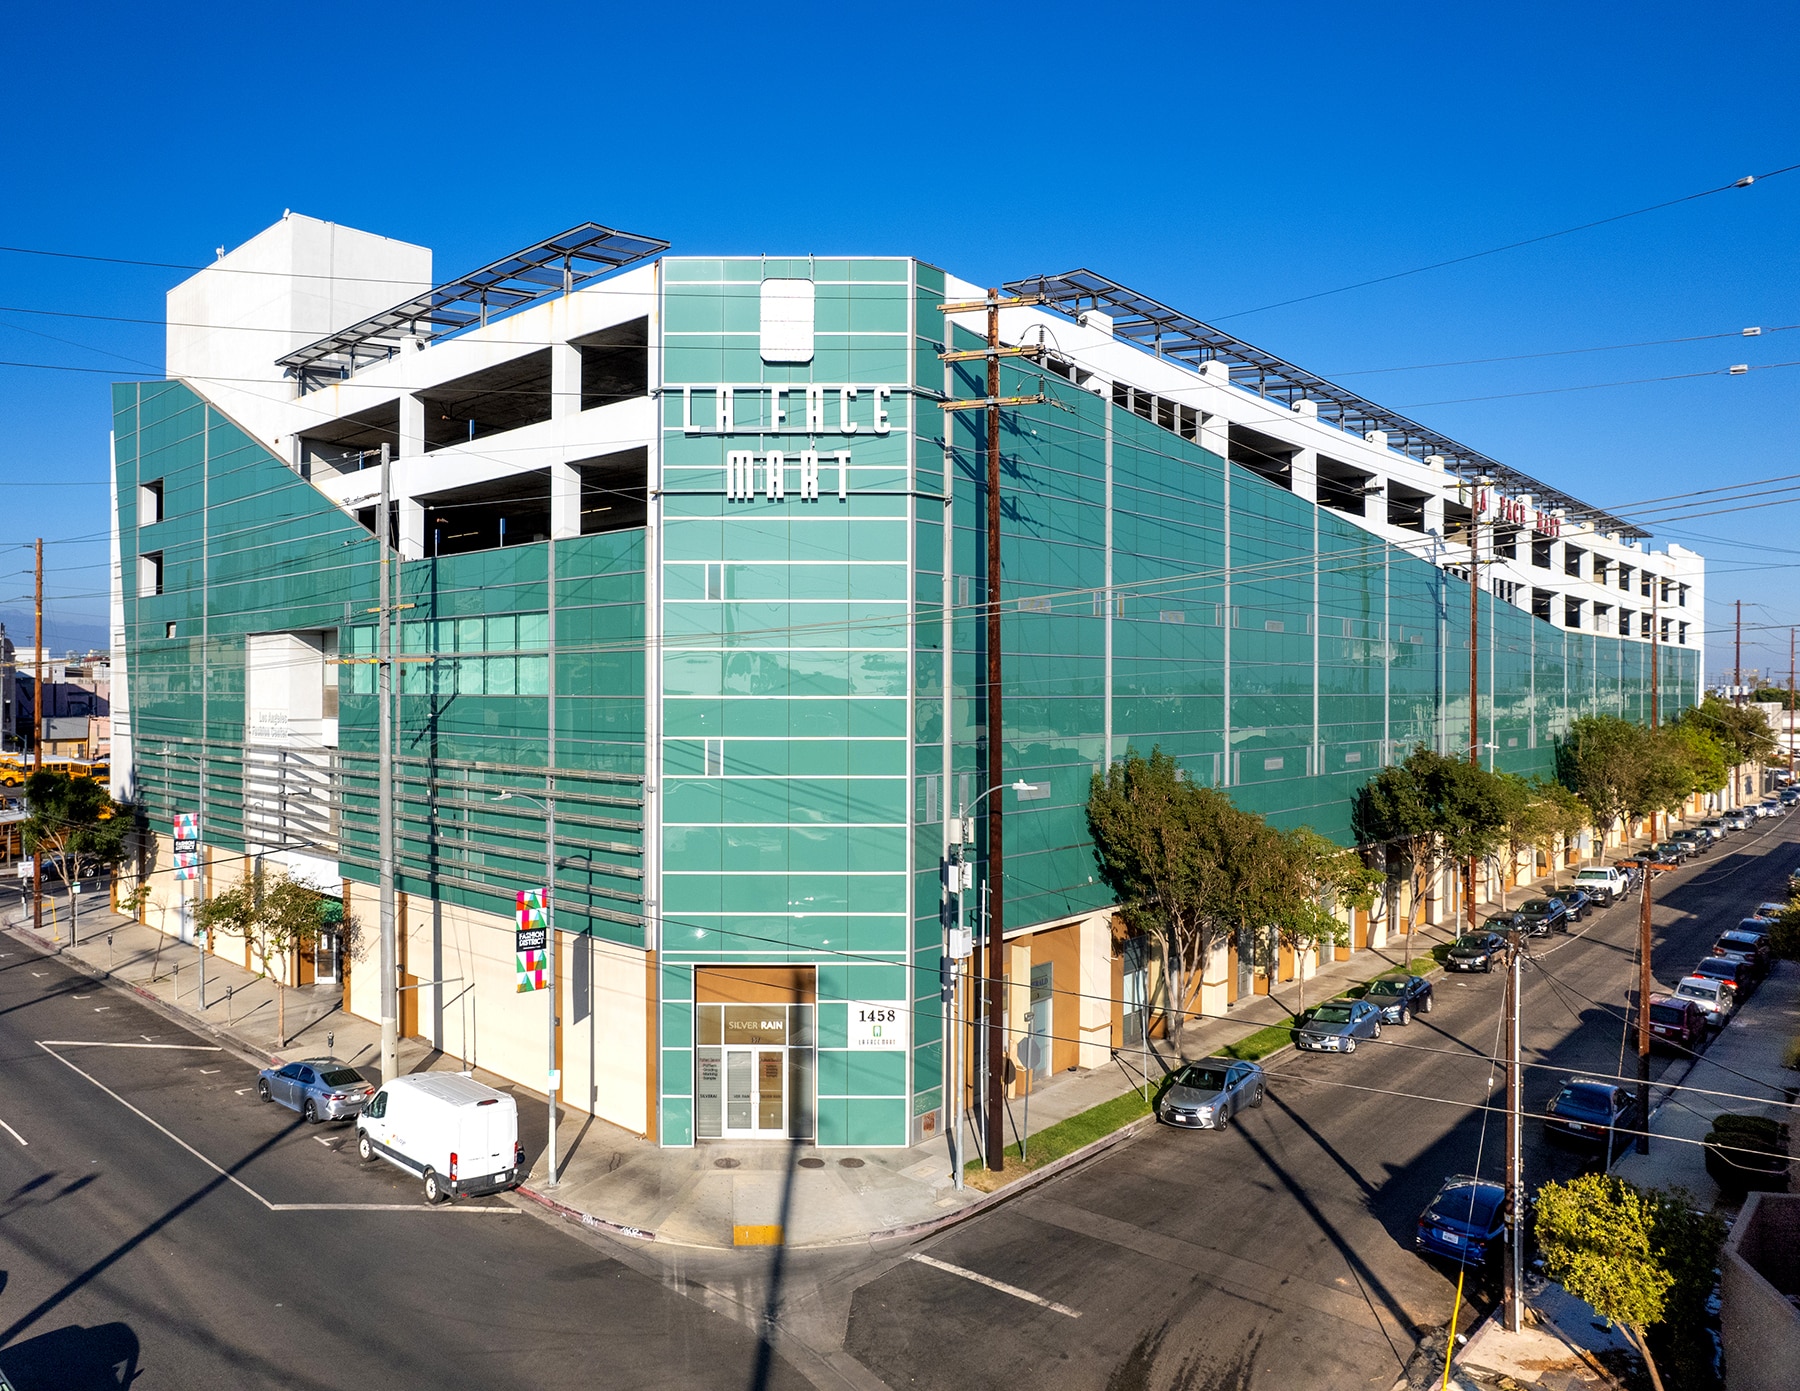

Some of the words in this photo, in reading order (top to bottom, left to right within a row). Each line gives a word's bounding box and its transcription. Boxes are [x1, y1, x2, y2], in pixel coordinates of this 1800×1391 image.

[683, 384, 734, 433] LA
[771, 384, 891, 433] FACE
[727, 450, 851, 499] MART
[519, 930, 545, 940] FASHION
[519, 937, 544, 946] DISTRICT
[859, 1010, 896, 1022] 1458
[728, 1021, 758, 1030] SILVER
[760, 1021, 783, 1030] RAIN
